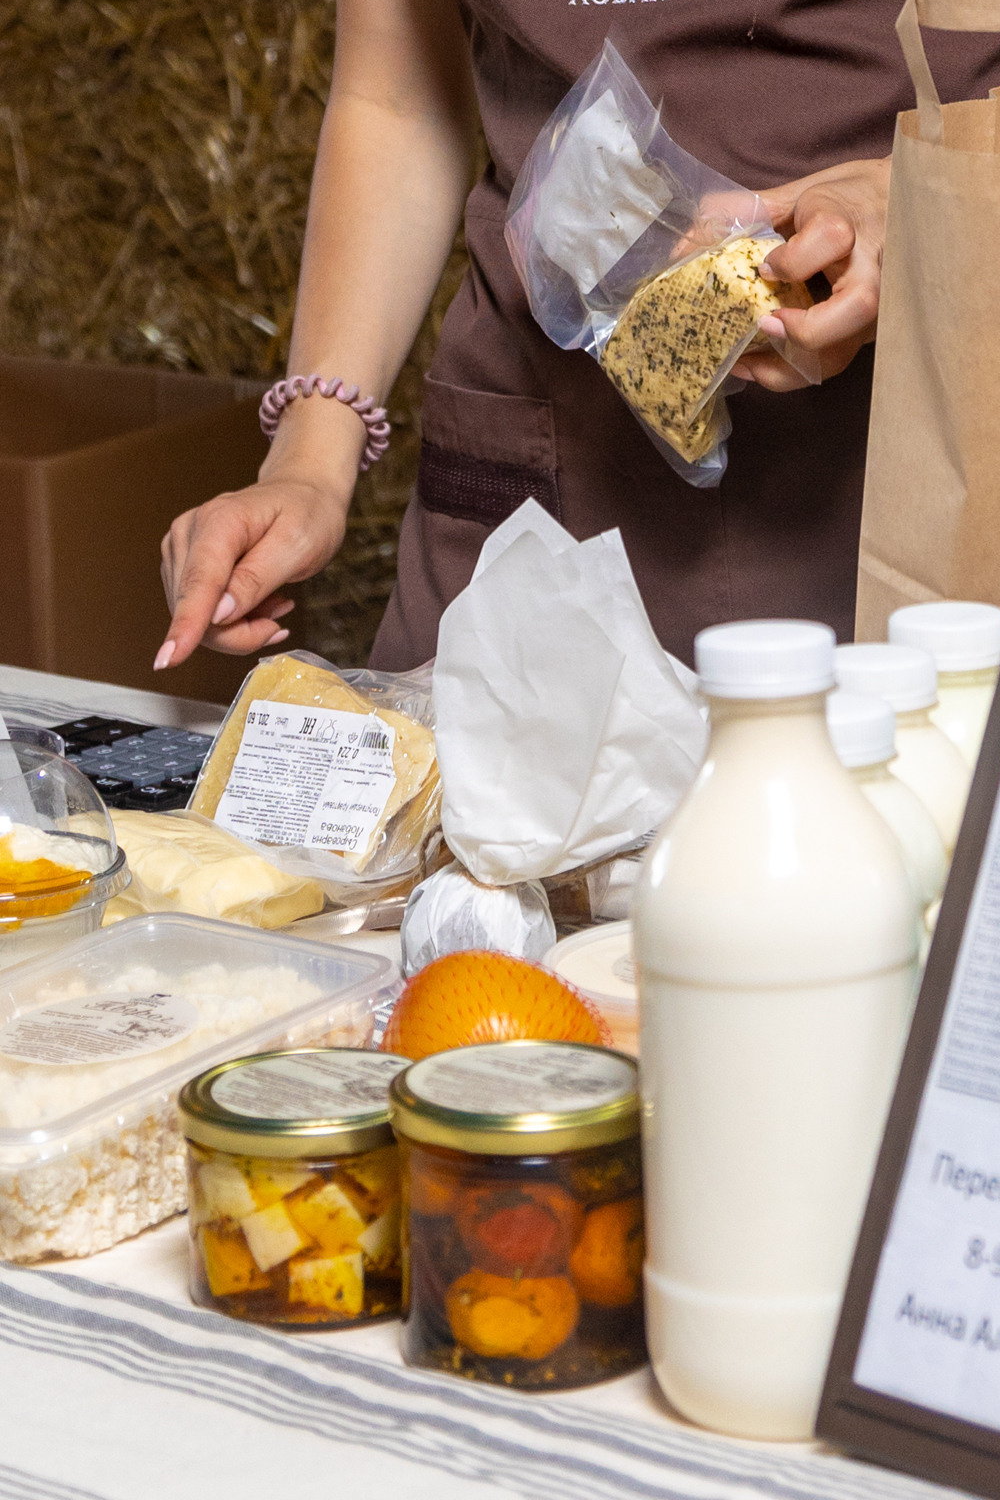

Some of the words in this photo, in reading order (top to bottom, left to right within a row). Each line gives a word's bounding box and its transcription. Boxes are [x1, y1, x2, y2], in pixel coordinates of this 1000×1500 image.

[320, 821, 364, 838] Лобанова
[311, 834, 358, 851] Сыроварня
[896, 1293, 968, 1341] Анна
